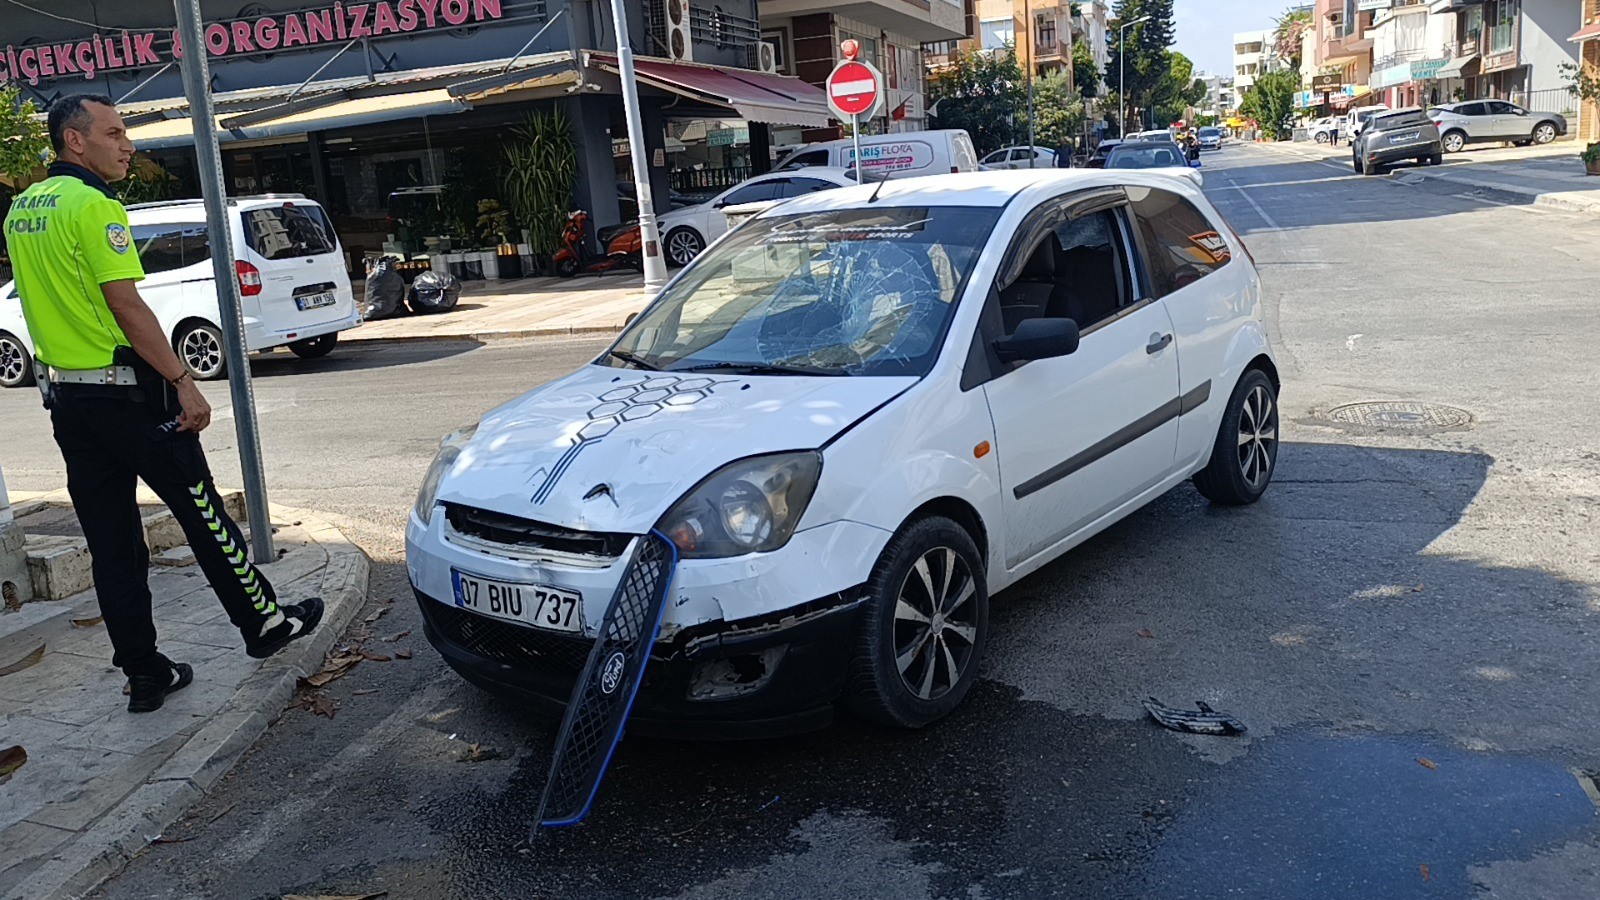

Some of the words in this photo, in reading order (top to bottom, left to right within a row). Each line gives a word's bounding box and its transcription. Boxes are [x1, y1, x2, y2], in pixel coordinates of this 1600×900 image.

[204, 0, 502, 56] ORGANİZASYON
[11, 193, 61, 211] TRAFİK
[461, 578, 478, 607] 07
[488, 584, 522, 616] BIU
[534, 590, 576, 627] 737
[604, 658, 622, 688] Ford
